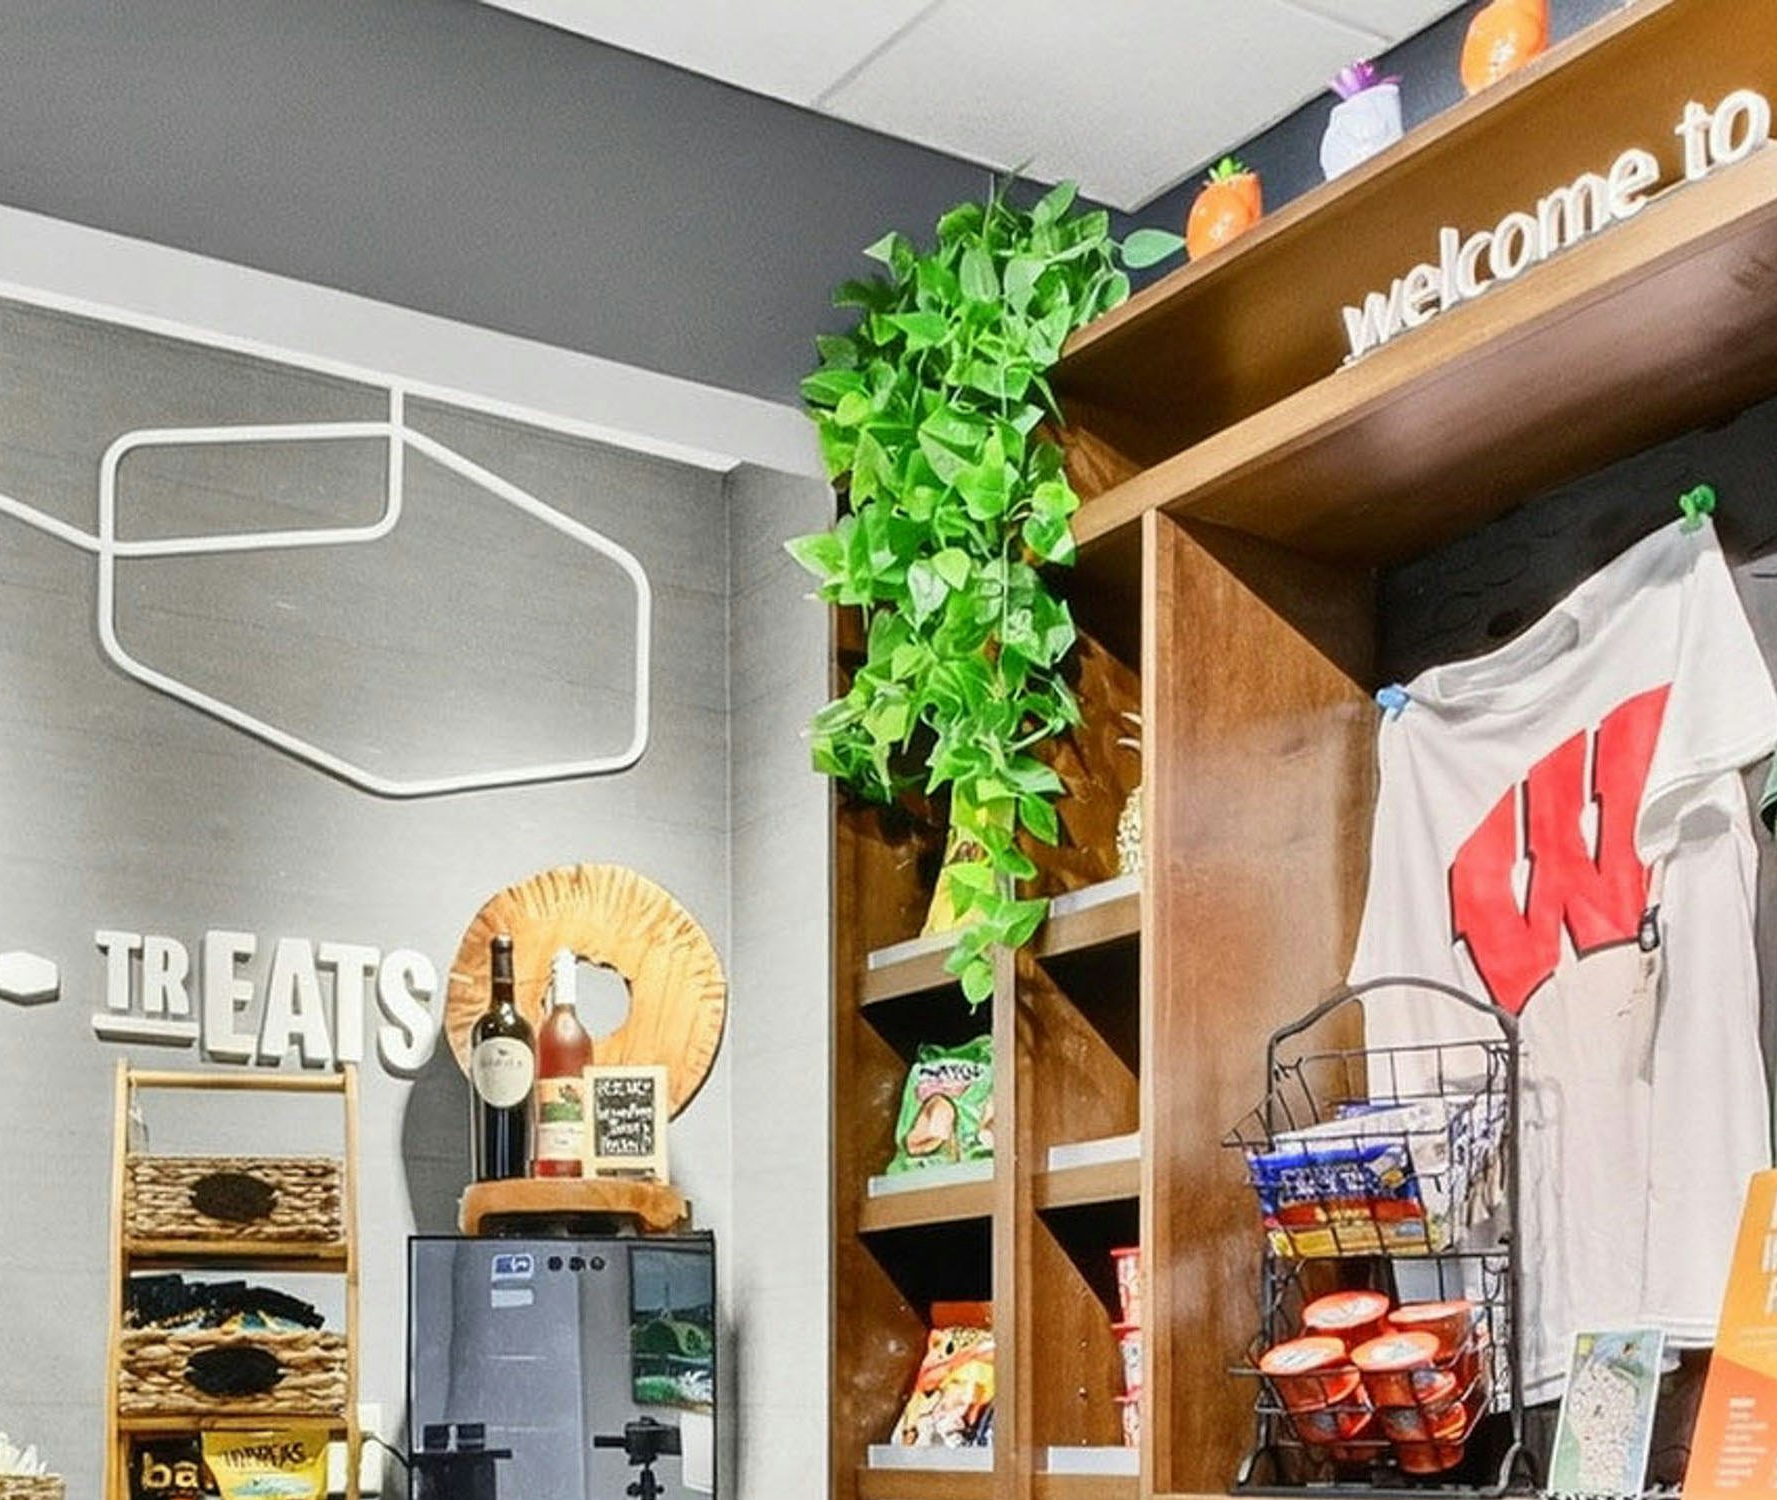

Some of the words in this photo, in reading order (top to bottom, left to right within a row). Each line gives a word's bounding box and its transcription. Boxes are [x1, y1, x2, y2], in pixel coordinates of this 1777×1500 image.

[1340, 147, 1662, 360] welcome
[1675, 90, 1772, 180] to
[1449, 683, 1672, 1010] W
[92, 930, 439, 1076] TREATS
